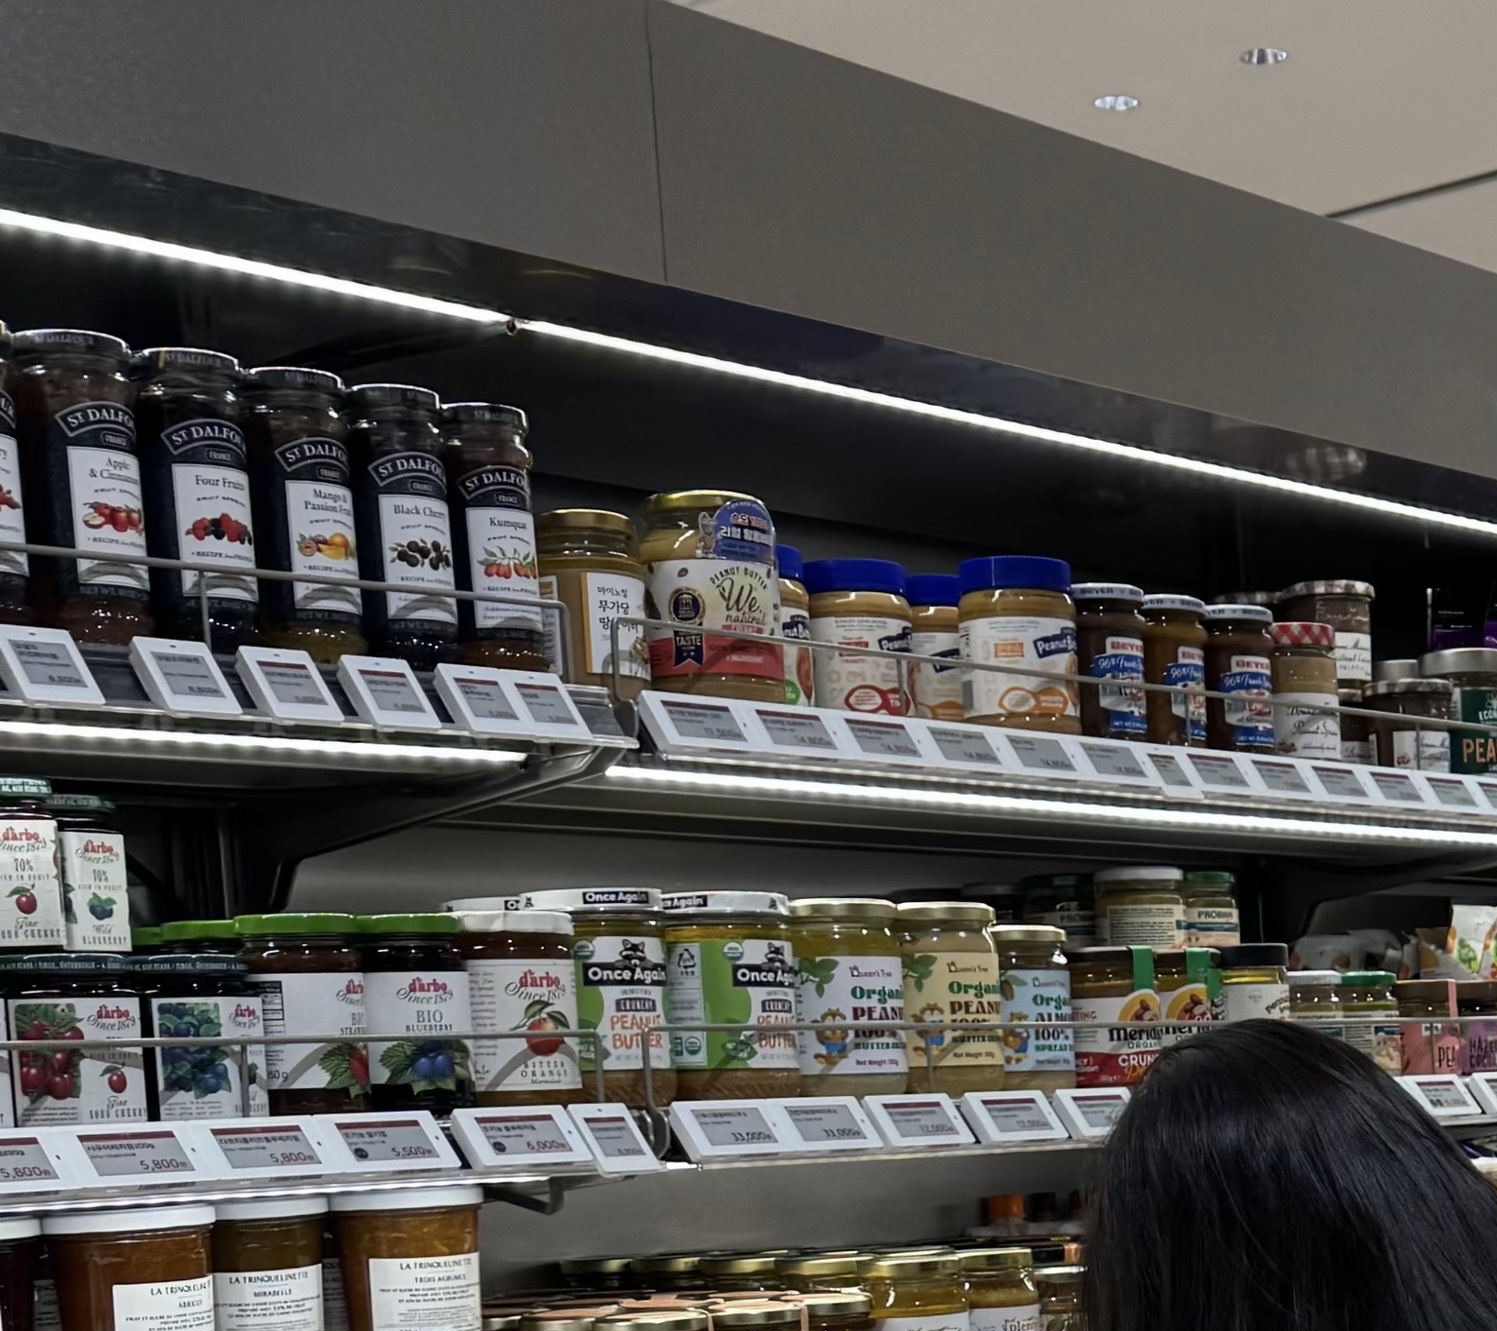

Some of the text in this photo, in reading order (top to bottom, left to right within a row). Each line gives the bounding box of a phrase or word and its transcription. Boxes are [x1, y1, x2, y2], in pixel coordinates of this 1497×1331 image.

[195, 475, 220, 487] Four
[394, 505, 421, 517] Black
[598, 601, 630, 615] 무가당
[585, 891, 616, 902] Once
[588, 966, 631, 982] Once
[737, 968, 774, 982] Once
[416, 1009, 443, 1024] BIO
[610, 1014, 661, 1031] PEANUT
[612, 1034, 663, 1049] BUTER
